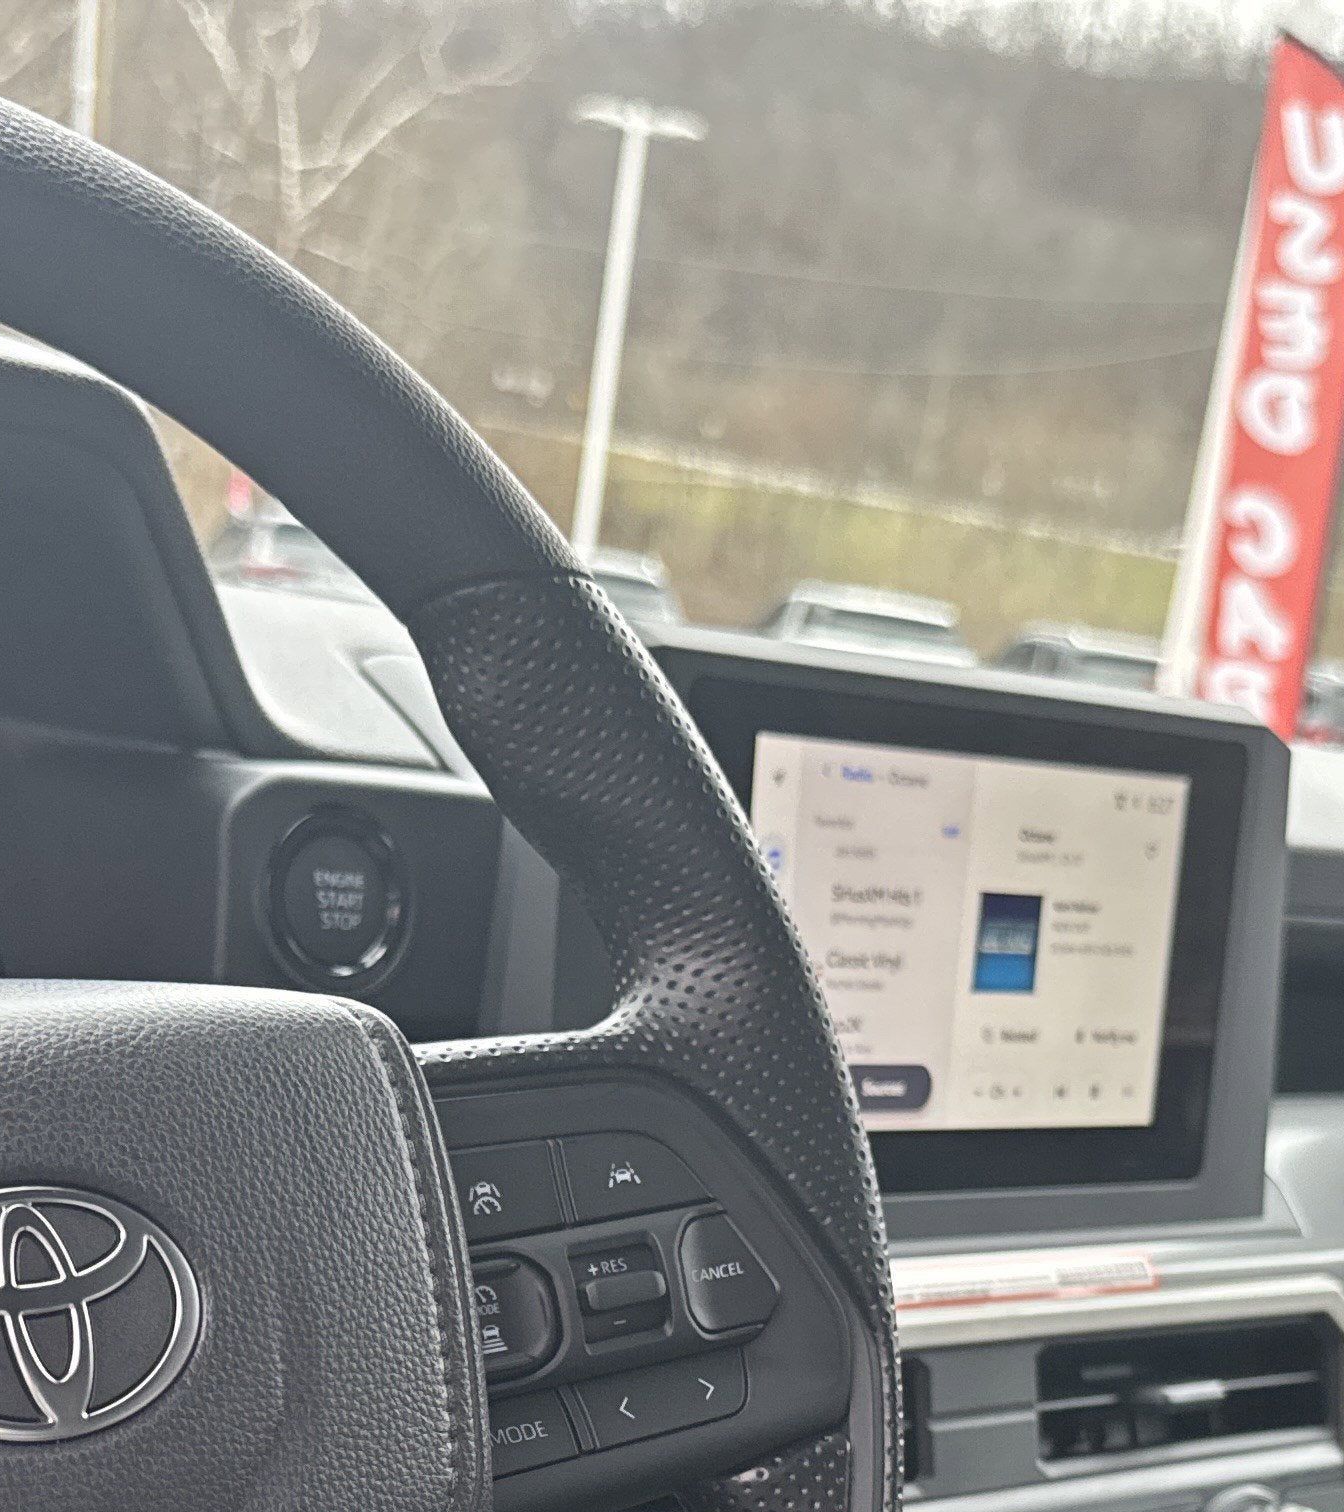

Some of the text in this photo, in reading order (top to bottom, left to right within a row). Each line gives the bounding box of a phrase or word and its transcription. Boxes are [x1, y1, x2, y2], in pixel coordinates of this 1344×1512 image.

[313, 869, 364, 889] ENGINE
[317, 889, 364, 910] START
[320, 910, 363, 931] STOP
[691, 1261, 744, 1282] CANCEL
[490, 1420, 549, 1447] MODE
